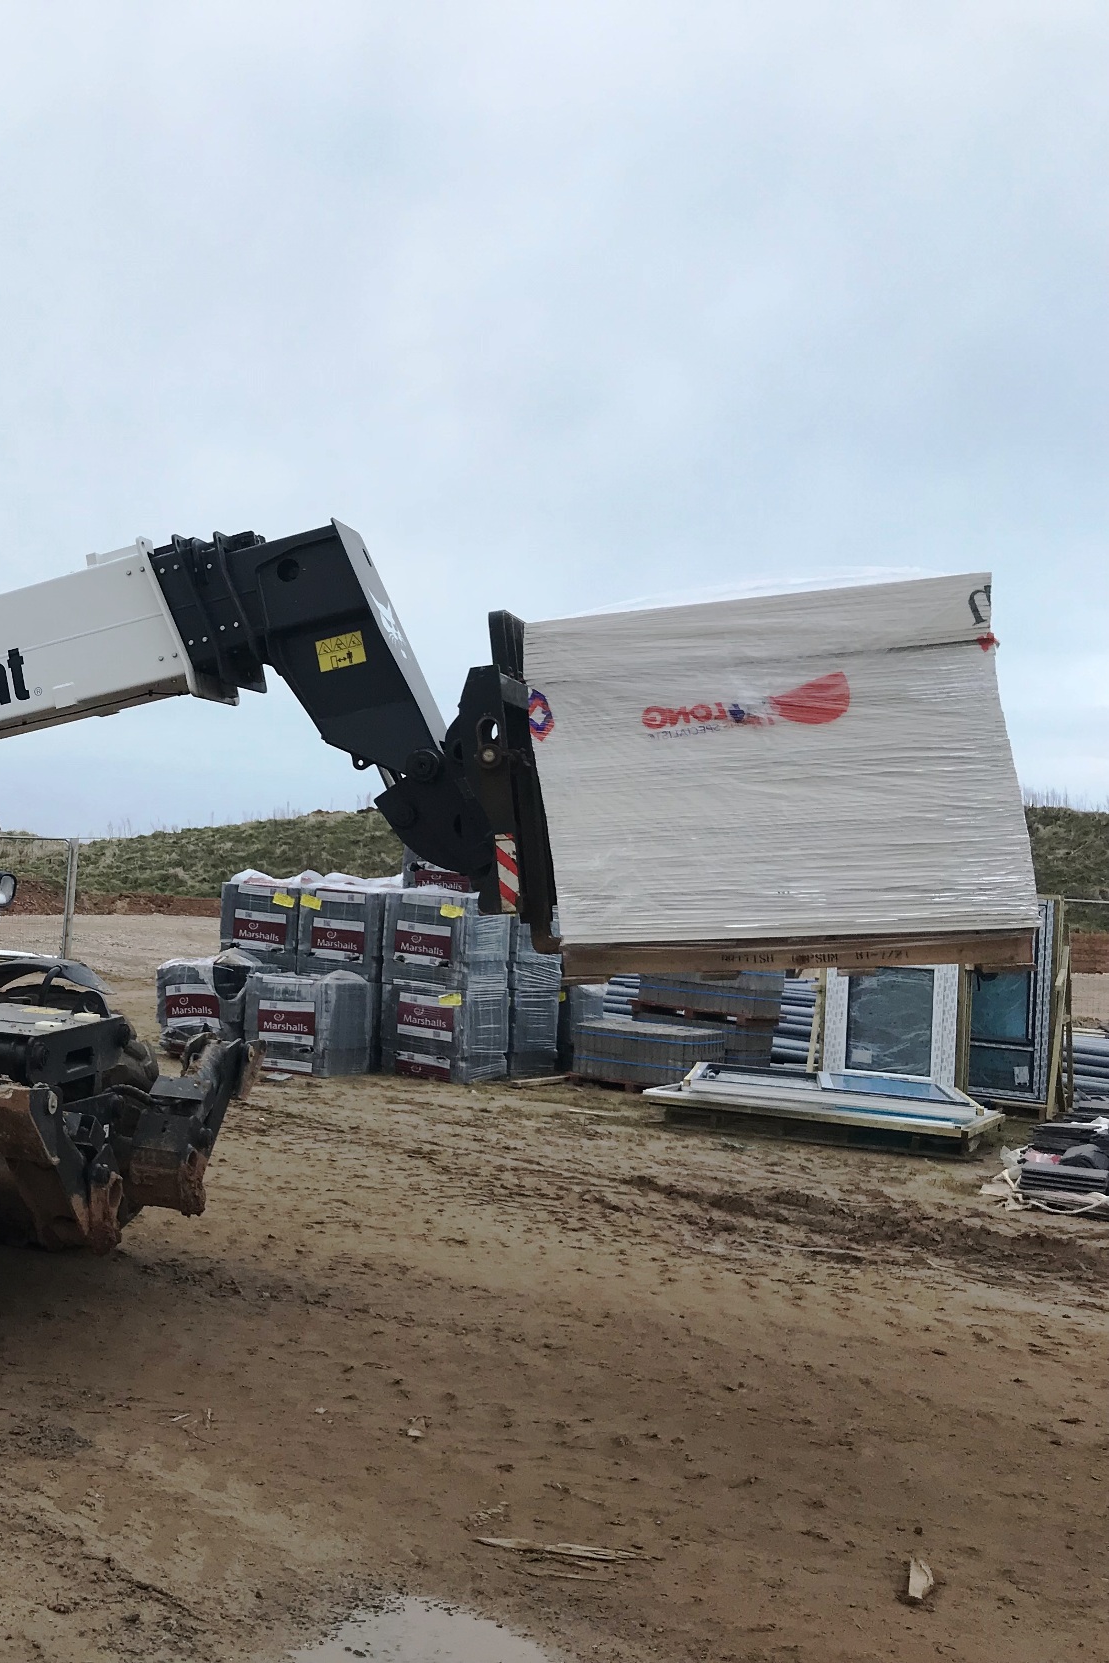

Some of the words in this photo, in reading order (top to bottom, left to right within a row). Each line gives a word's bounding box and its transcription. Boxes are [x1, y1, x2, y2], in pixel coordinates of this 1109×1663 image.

[238, 929, 280, 942] Marshalls
[317, 938, 358, 951] Marshalls
[400, 942, 444, 956] Marshalls
[171, 1005, 213, 1016] Marshalls
[263, 1021, 309, 1033] Marshalls
[403, 1014, 447, 1028] Marshalls
